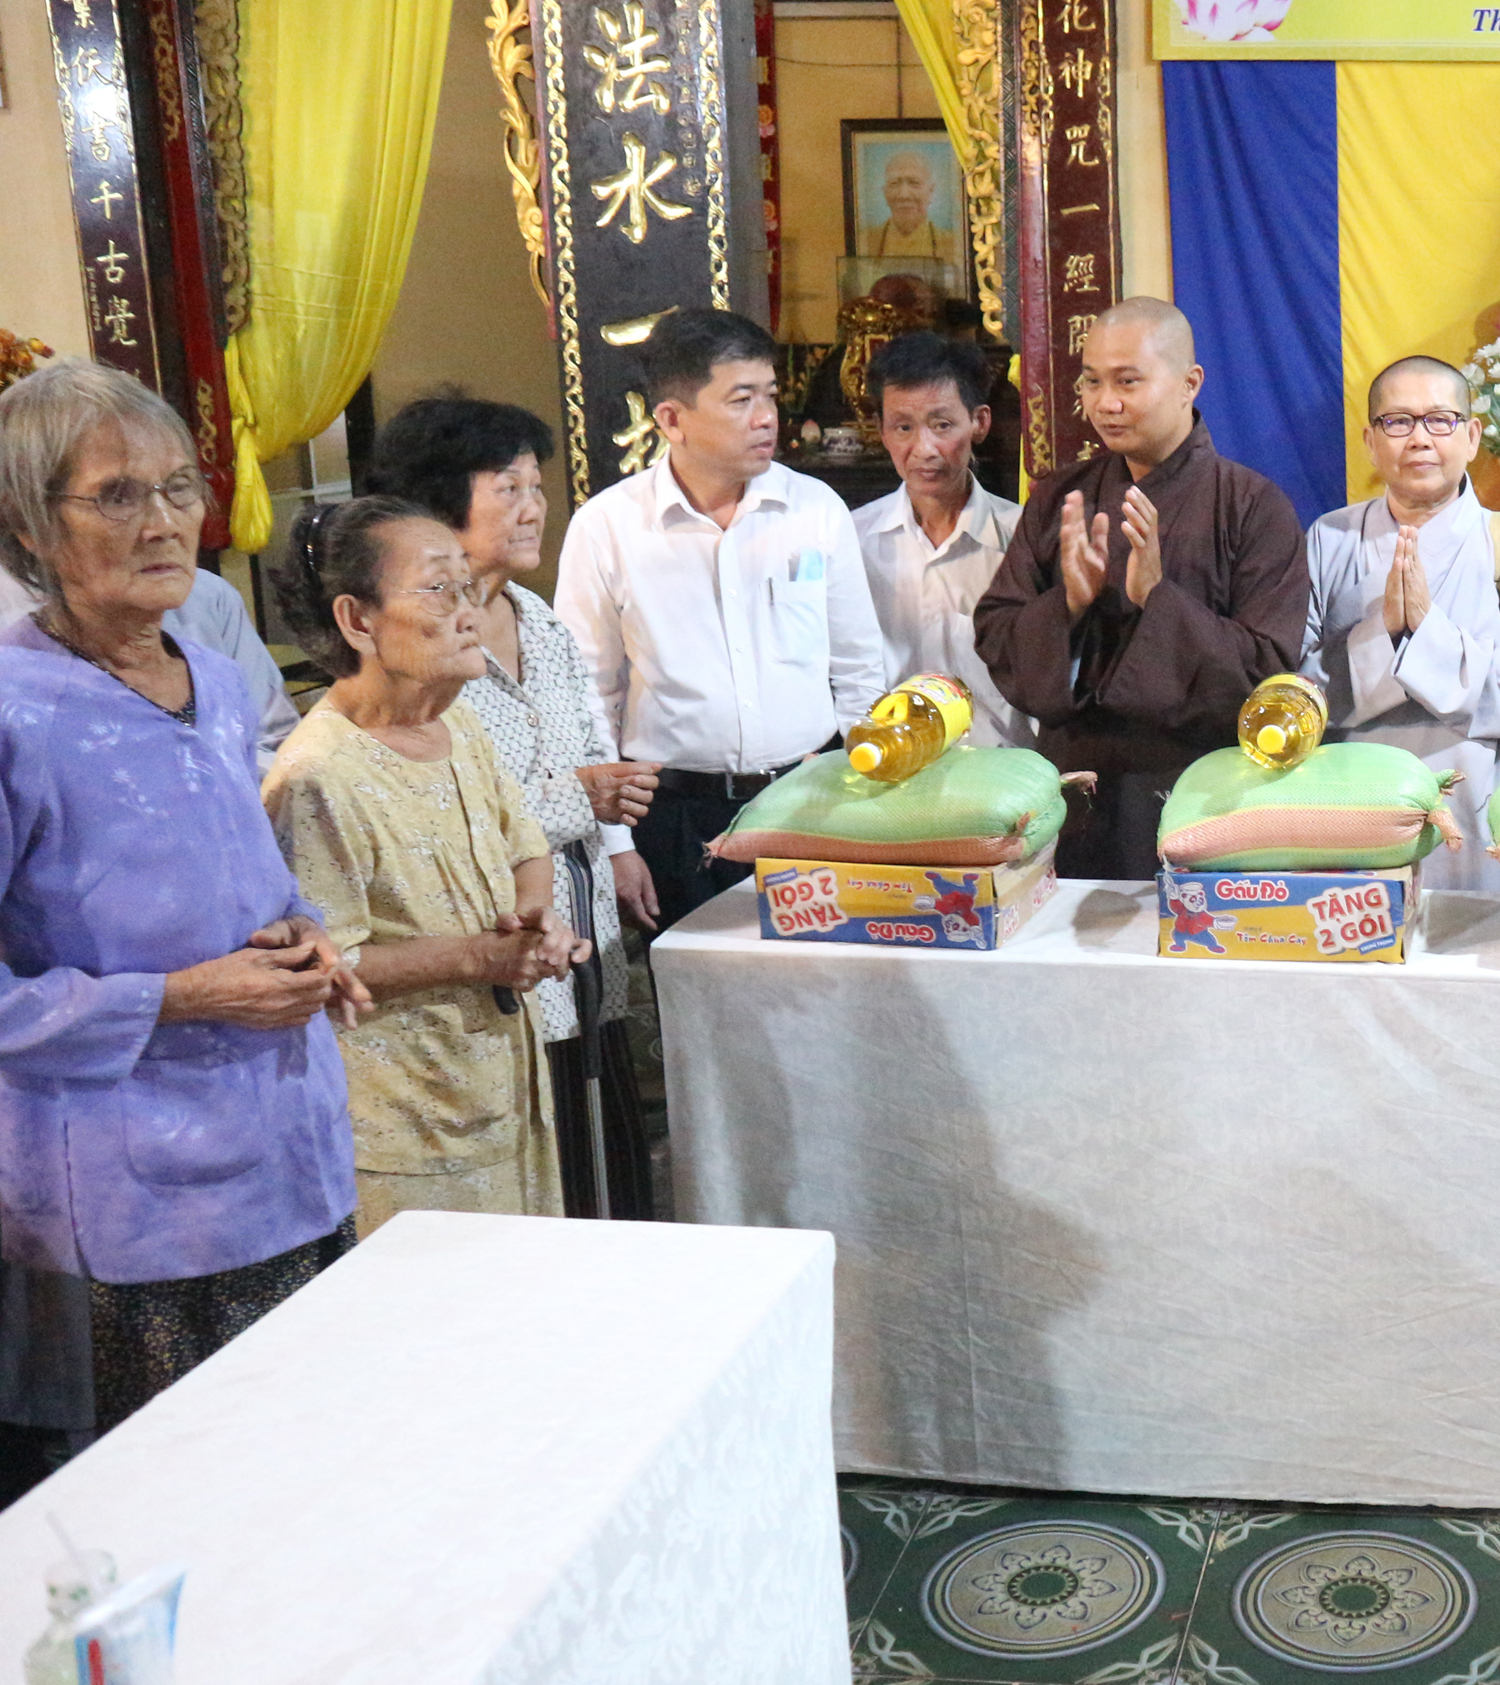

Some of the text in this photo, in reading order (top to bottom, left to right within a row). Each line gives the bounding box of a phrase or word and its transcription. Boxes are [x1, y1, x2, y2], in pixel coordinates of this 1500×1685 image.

[818, 876, 834, 895] 2
[777, 901, 843, 932] TẶNG
[1312, 887, 1383, 924] TẶNG
[1319, 929, 1336, 948] 2
[1340, 913, 1387, 943] GÓI
